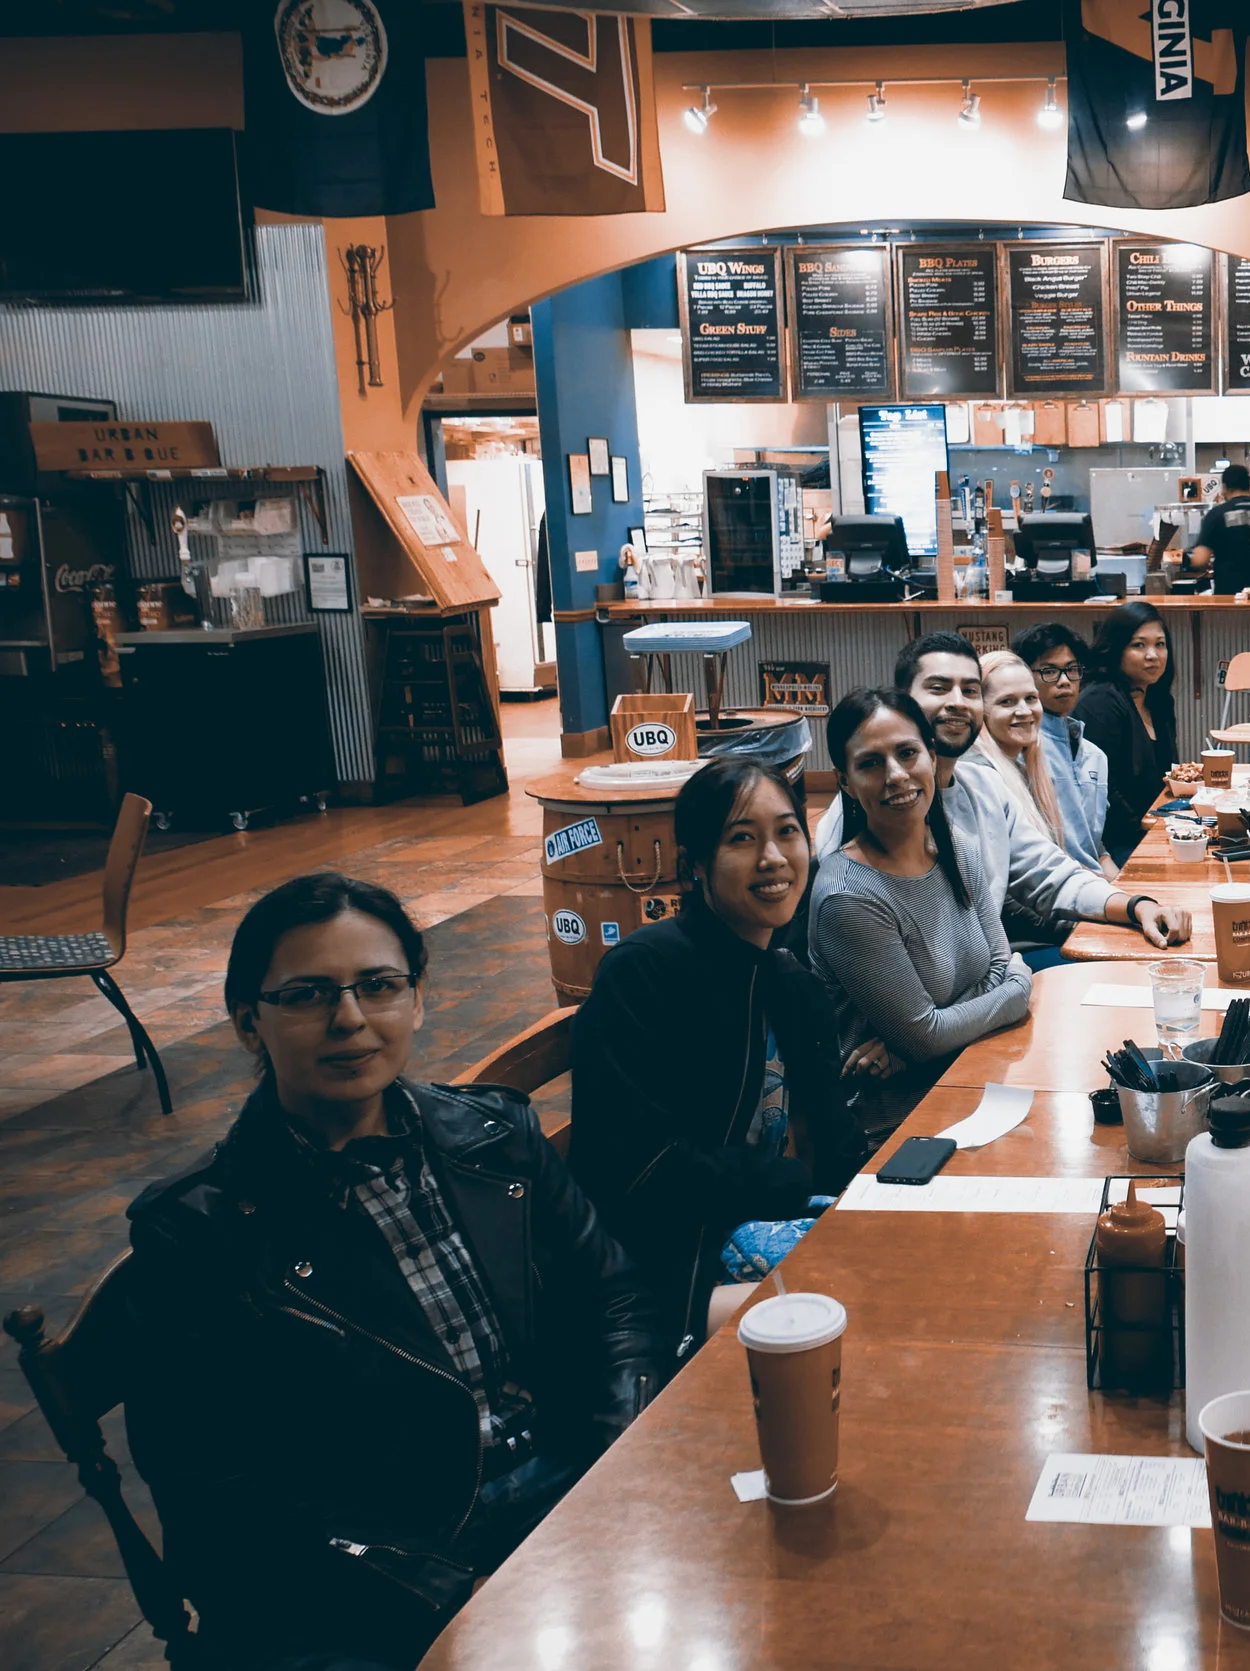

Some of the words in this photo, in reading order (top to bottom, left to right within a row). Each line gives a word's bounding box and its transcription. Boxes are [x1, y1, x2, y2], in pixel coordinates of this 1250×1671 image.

[697, 262, 727, 276] UBQ
[799, 262, 823, 273] BBQ
[919, 258, 943, 269] BBQ
[94, 427, 159, 443] URBAN
[77, 446, 115, 463] BAR
[1203, 479, 1219, 495] UBQ
[961, 631, 1005, 643] MUSTANG
[633, 730, 669, 746] UBQ
[556, 832, 570, 855] AIR
[567, 820, 599, 850] FORCE
[556, 917, 581, 935] UBQ
